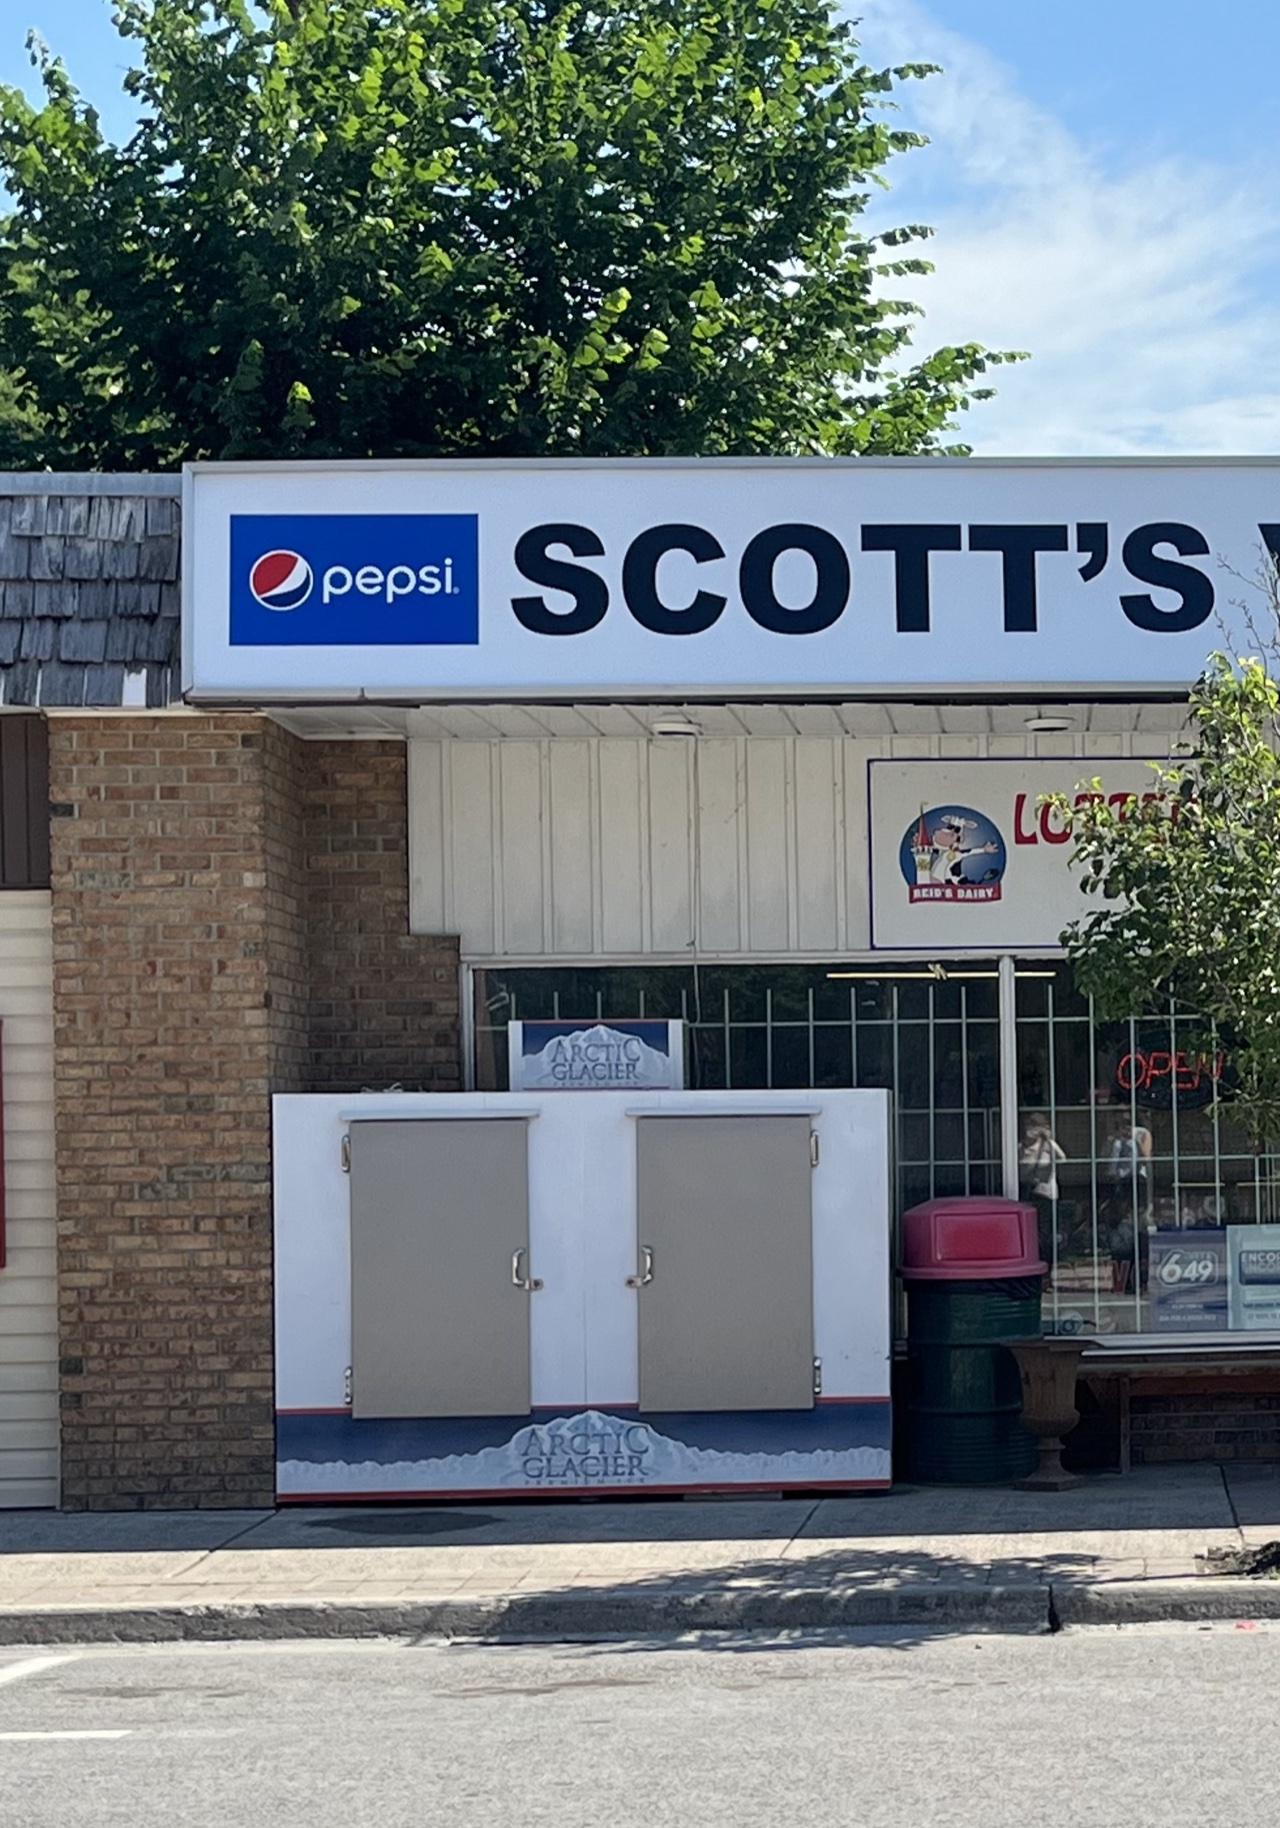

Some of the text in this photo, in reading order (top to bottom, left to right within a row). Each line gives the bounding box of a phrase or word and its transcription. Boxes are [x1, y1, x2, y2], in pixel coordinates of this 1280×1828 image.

[322, 557, 454, 603] pepsi
[511, 521, 1215, 635] SCOTT'S
[913, 888, 994, 899] REID'S DAIRY
[551, 1038, 641, 1063] ARCTIC
[551, 1062, 640, 1081] GLACIER
[521, 1426, 649, 1456] ARCTIC
[522, 1455, 649, 1479] GLACIER
